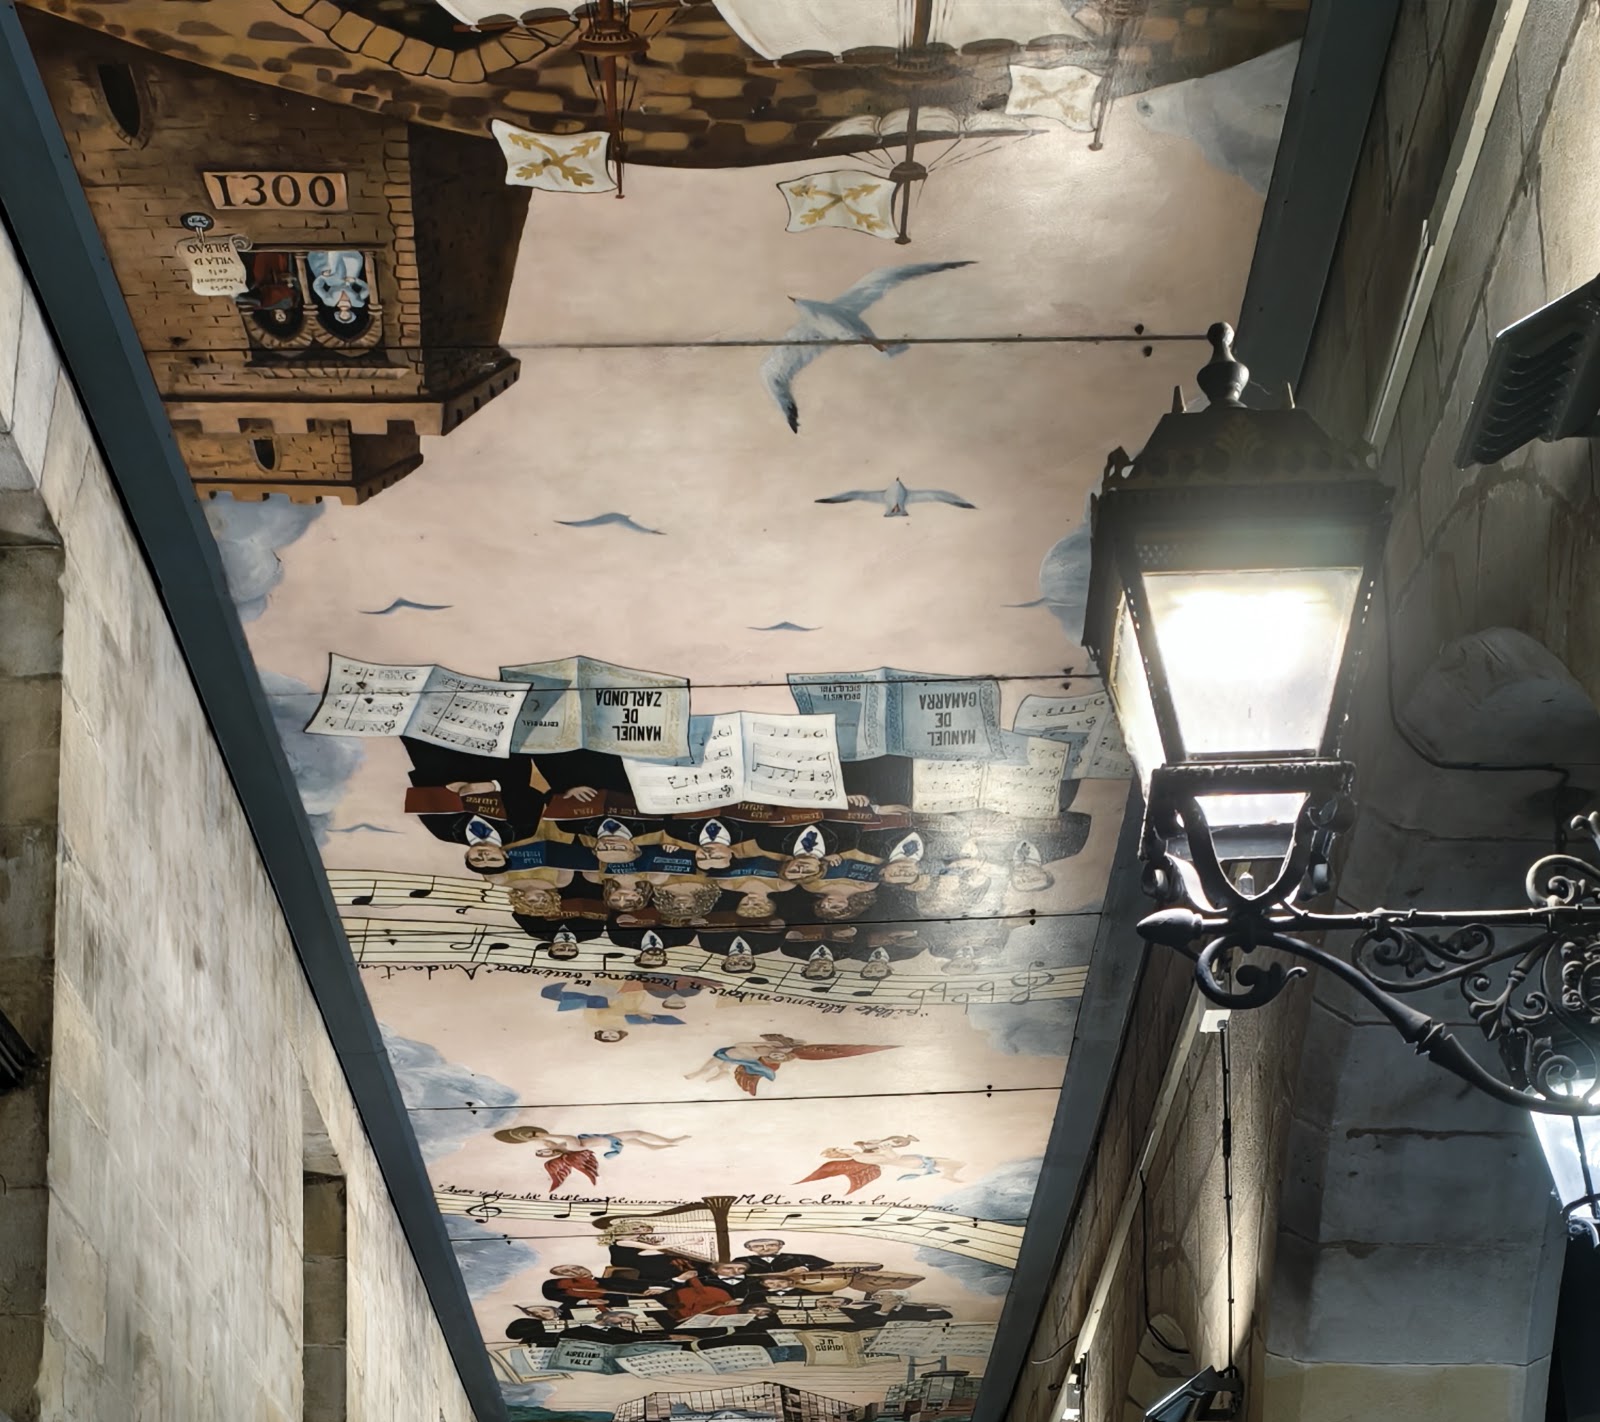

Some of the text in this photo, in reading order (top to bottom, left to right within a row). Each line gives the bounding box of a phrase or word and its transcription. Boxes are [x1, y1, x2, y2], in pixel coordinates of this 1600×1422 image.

[212, 174, 336, 207] 1300
[187, 243, 230, 255] BILBAO
[594, 689, 662, 708] ZARLONDA
[919, 692, 978, 710] GAMARRA
[521, 719, 560, 728] EDITORIAL
[621, 708, 638, 724] DE
[935, 711, 953, 728] DE
[611, 725, 661, 741] MANUEL
[928, 730, 977, 746] MANUEL
[734, 1193, 791, 1206] Molto
